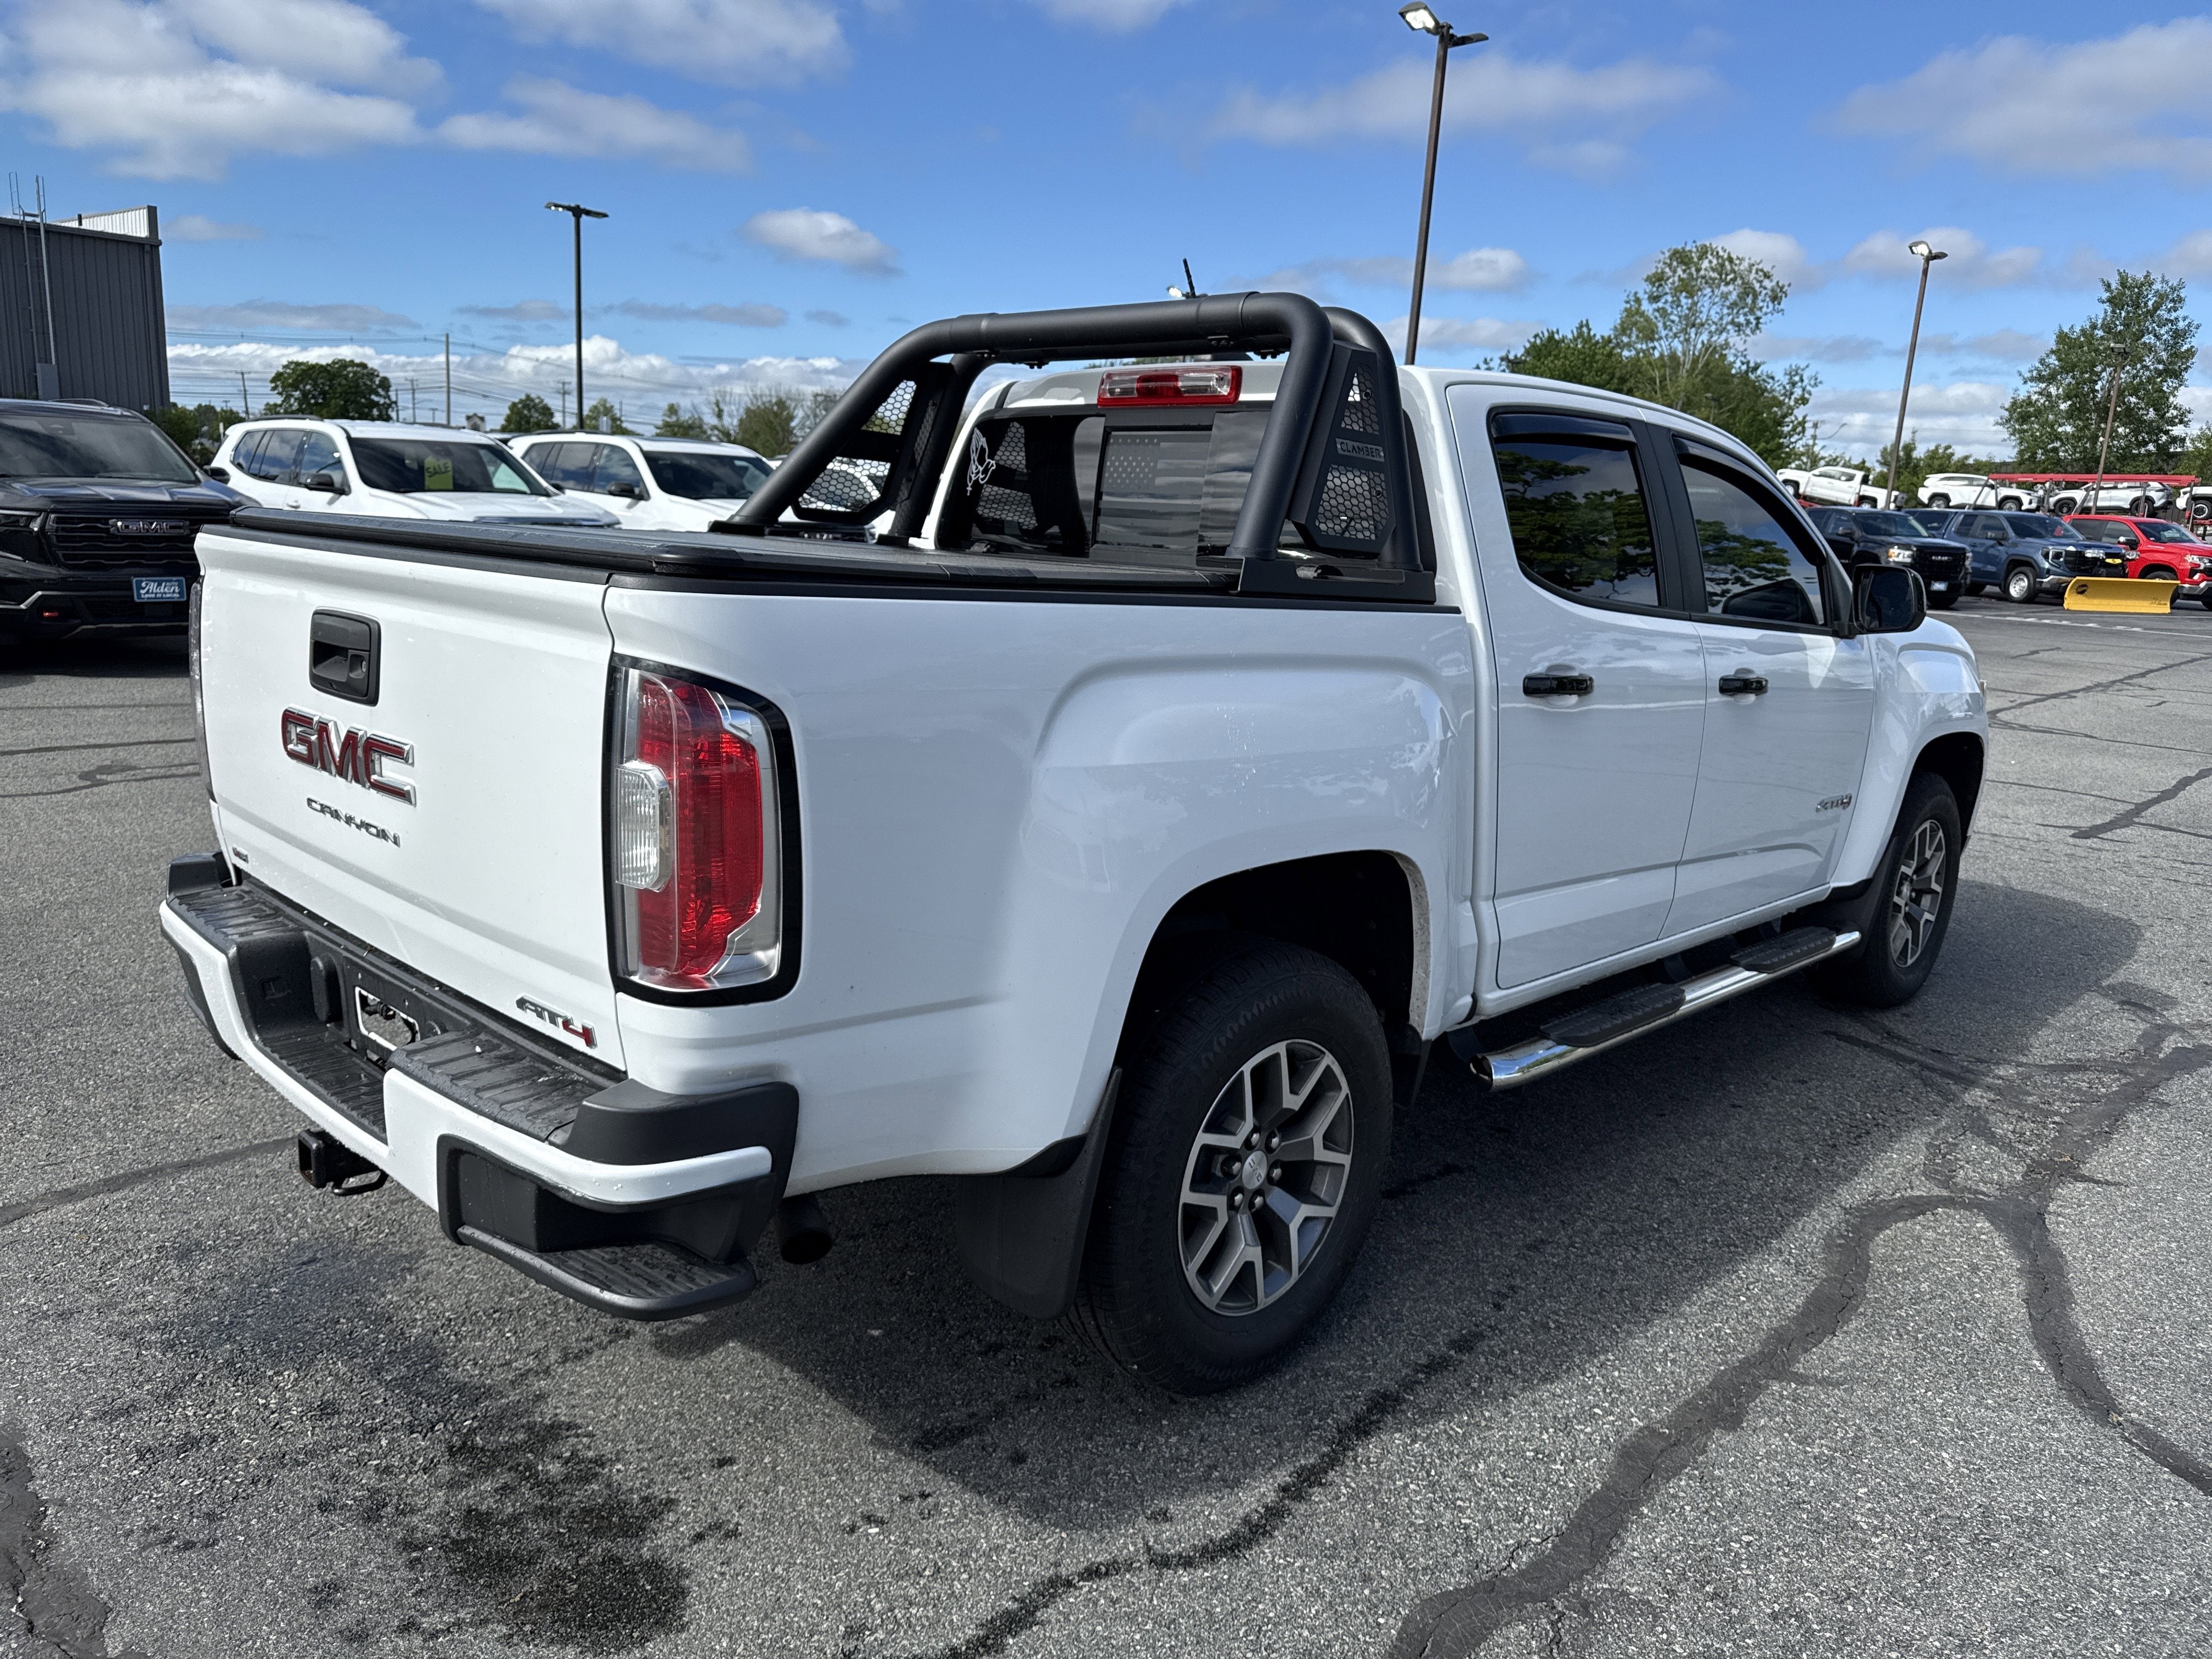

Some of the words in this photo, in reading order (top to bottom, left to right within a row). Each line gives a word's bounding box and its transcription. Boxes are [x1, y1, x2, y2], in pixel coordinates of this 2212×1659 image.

[1339, 441, 1381, 459] CLAMBER
[425, 462, 451, 478] SALE
[117, 521, 184, 534] GMC
[139, 580, 180, 594] Alden
[281, 706, 417, 808] GMC
[306, 797, 401, 848] CANYON
[515, 994, 597, 1049] AT4
[1248, 1158, 1262, 1183] GMC
